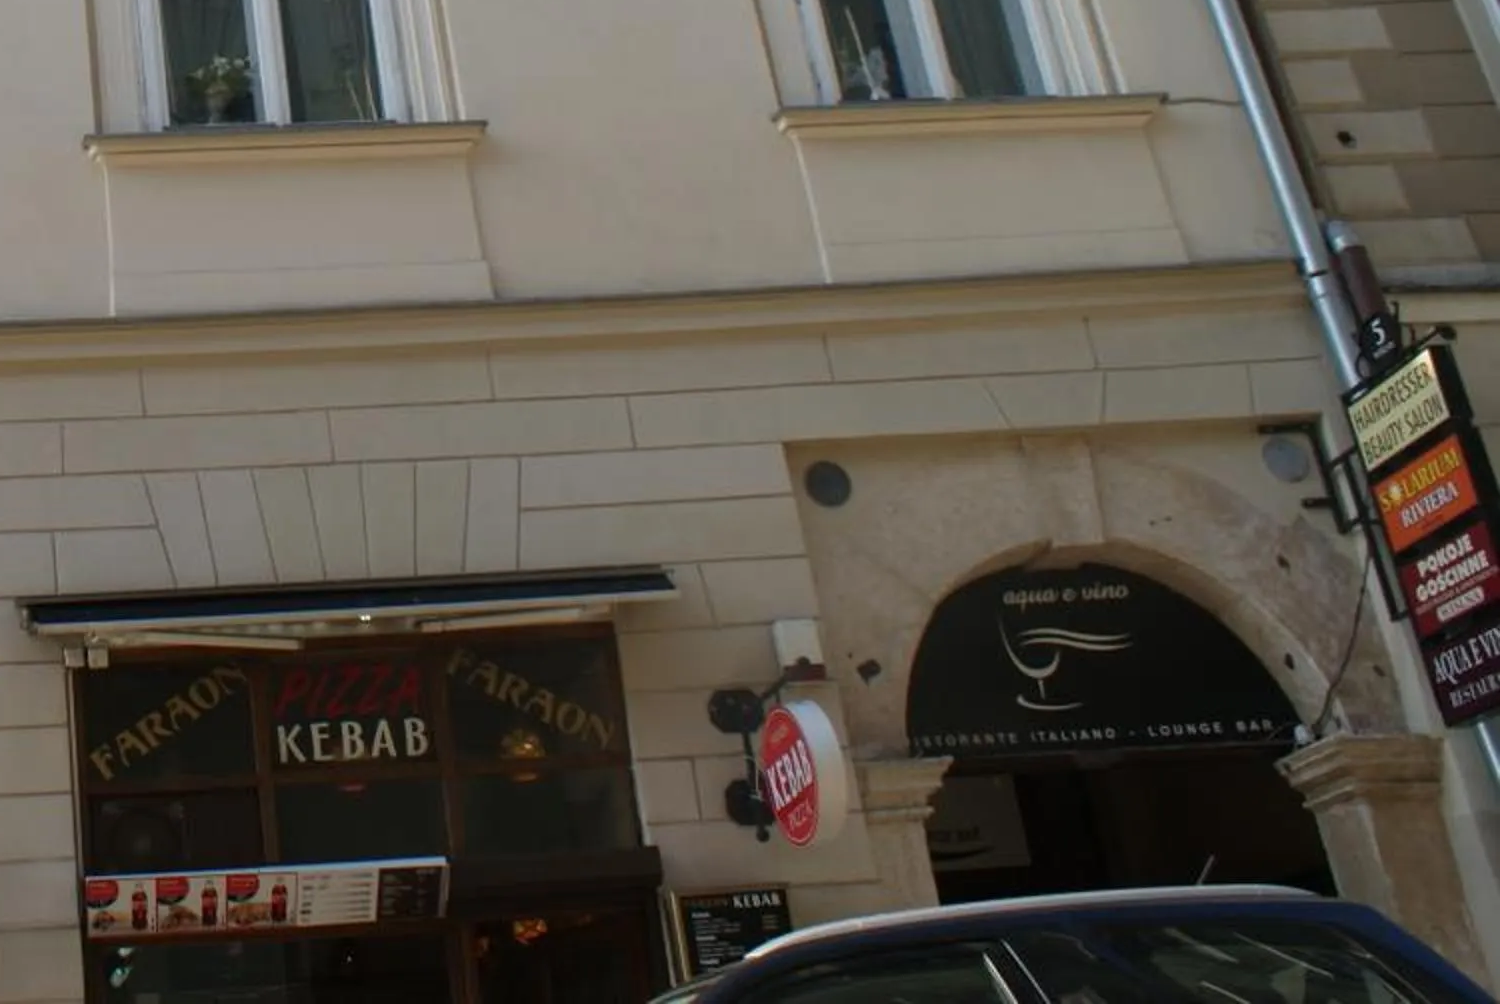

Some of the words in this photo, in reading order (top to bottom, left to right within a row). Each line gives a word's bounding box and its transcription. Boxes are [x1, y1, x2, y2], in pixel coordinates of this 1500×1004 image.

[1370, 317, 1386, 346] 5
[1353, 362, 1433, 431] HAIRDRESSER
[1364, 420, 1405, 464] BEAUTY
[1404, 394, 1444, 436] SALON
[1401, 480, 1460, 529] RIVIERA
[1415, 533, 1475, 578] POKOJE
[1080, 580, 1131, 601] vino
[1433, 643, 1473, 685] AQUA
[272, 660, 422, 720] PIZZA
[446, 648, 616, 751] FARAON
[88, 660, 248, 782] FARAON
[276, 716, 430, 764] KEBAB
[1030, 726, 1117, 743] ITALIANO
[1147, 721, 1224, 739] LOUNGE
[1236, 718, 1275, 734] BAR
[765, 738, 815, 812] KEBAB
[731, 890, 782, 909] KEBAB
